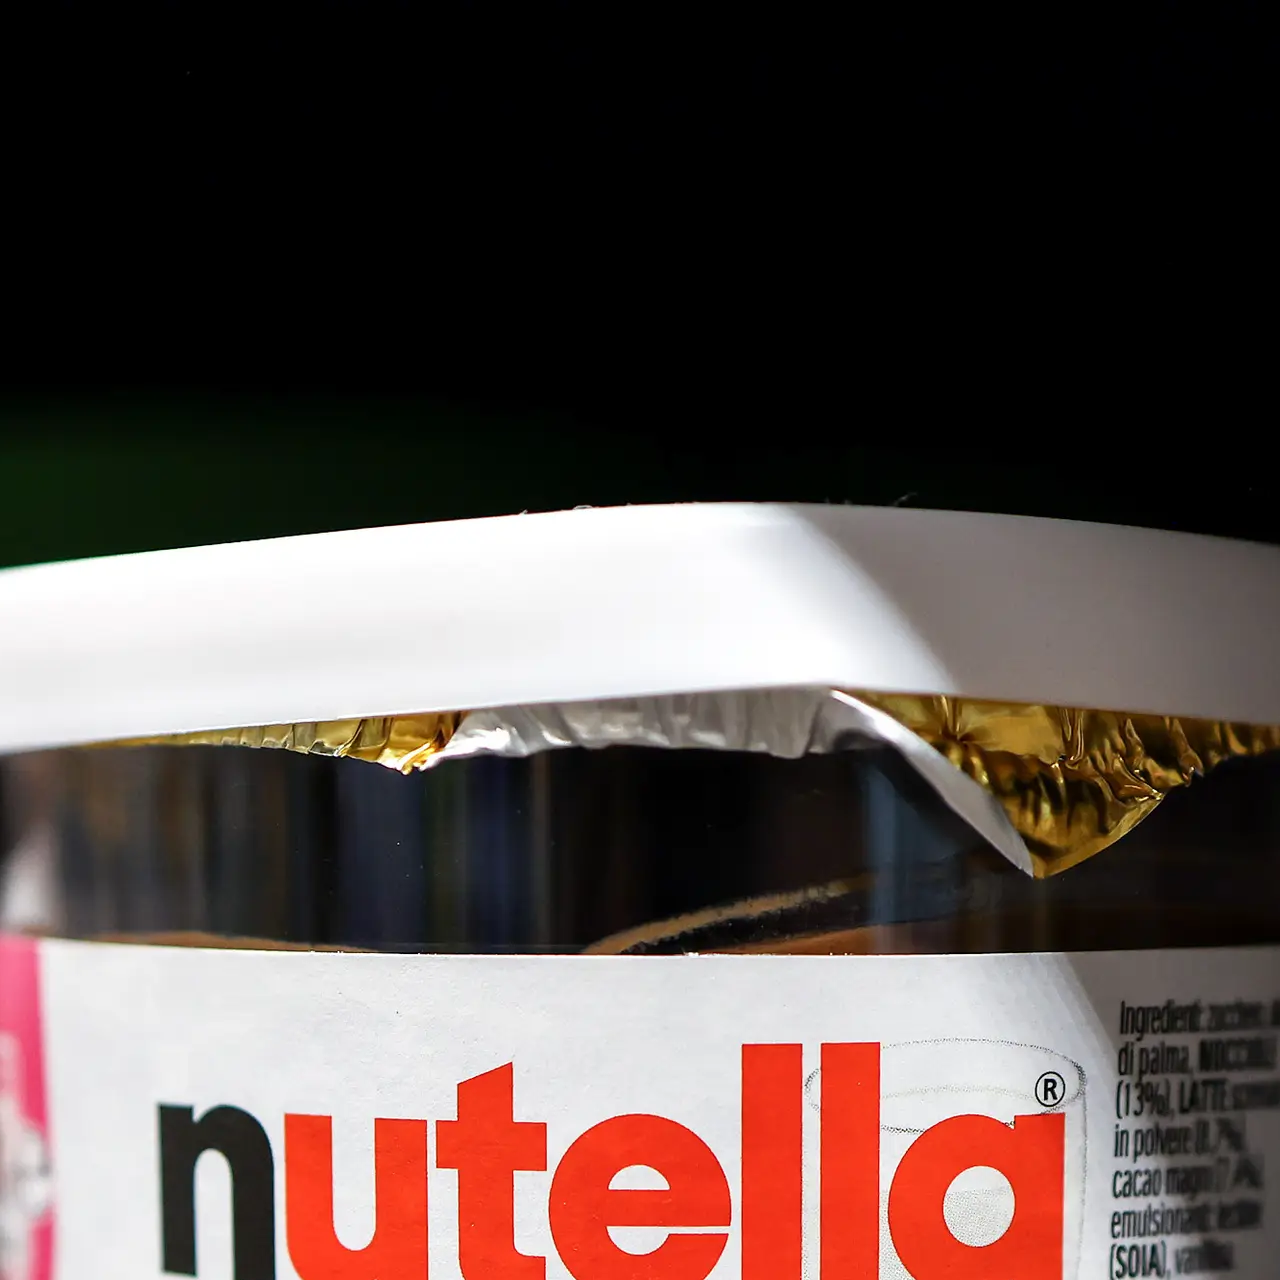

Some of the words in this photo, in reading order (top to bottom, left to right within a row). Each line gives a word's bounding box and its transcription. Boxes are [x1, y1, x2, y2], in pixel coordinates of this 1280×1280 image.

[1118, 1041, 1134, 1076] di
[1114, 1123, 1129, 1157] in
[1112, 1168, 1162, 1199] cacao
[1165, 1166, 1215, 1201] mag
